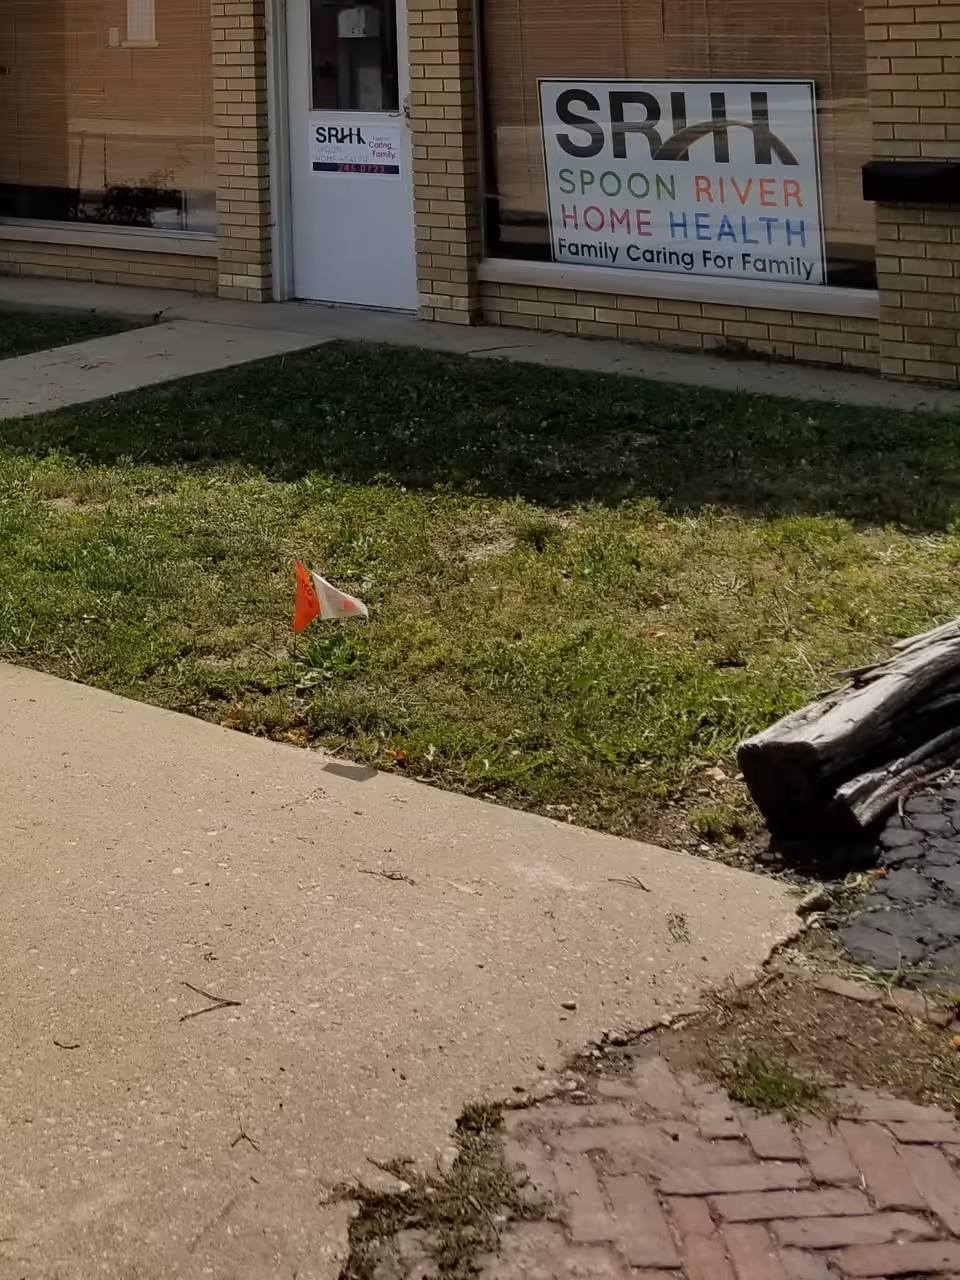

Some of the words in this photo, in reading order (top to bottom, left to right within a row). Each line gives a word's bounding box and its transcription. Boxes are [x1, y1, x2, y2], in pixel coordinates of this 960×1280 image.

[369, 141, 392, 150] Caring
[559, 168, 676, 201] SPOON
[694, 175, 803, 208] RIVER
[561, 204, 653, 237] HOME
[669, 211, 806, 248] HEALTH
[557, 237, 619, 264] Family
[626, 244, 695, 270] Caring
[702, 250, 734, 270] For
[742, 253, 815, 281] Family
